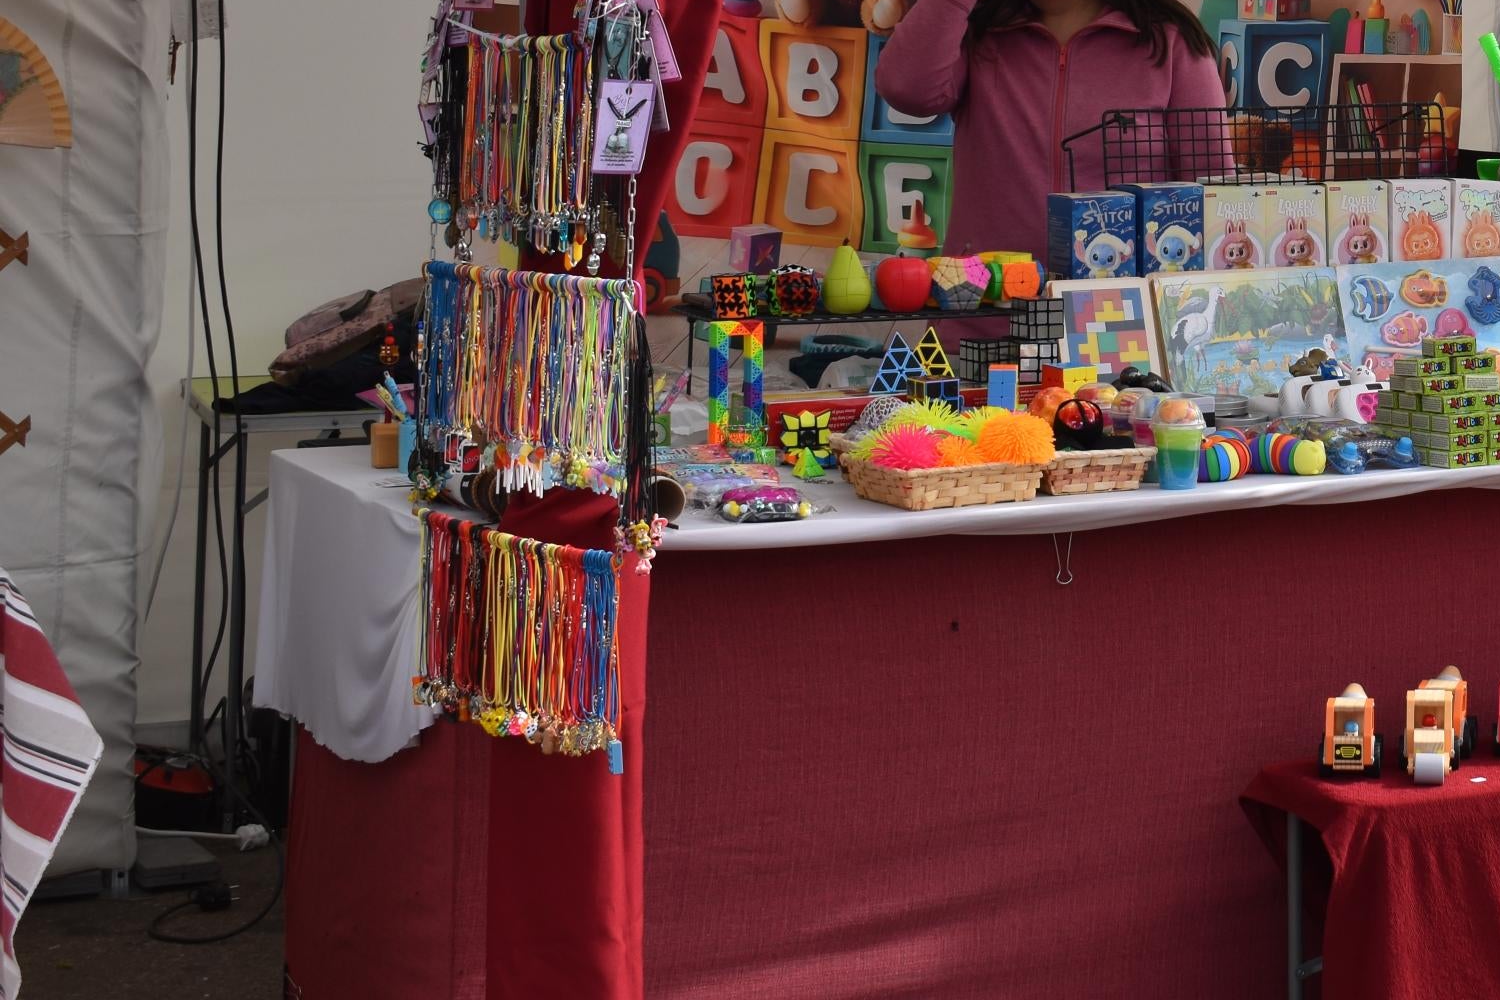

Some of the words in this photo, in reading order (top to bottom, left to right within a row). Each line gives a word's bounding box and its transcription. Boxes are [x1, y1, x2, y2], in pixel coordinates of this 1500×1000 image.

[787, 41, 840, 117] B
[1257, 41, 1313, 115] C
[783, 152, 839, 226] C
[1082, 209, 1133, 225] STITCH
[1153, 199, 1200, 216] STITCH
